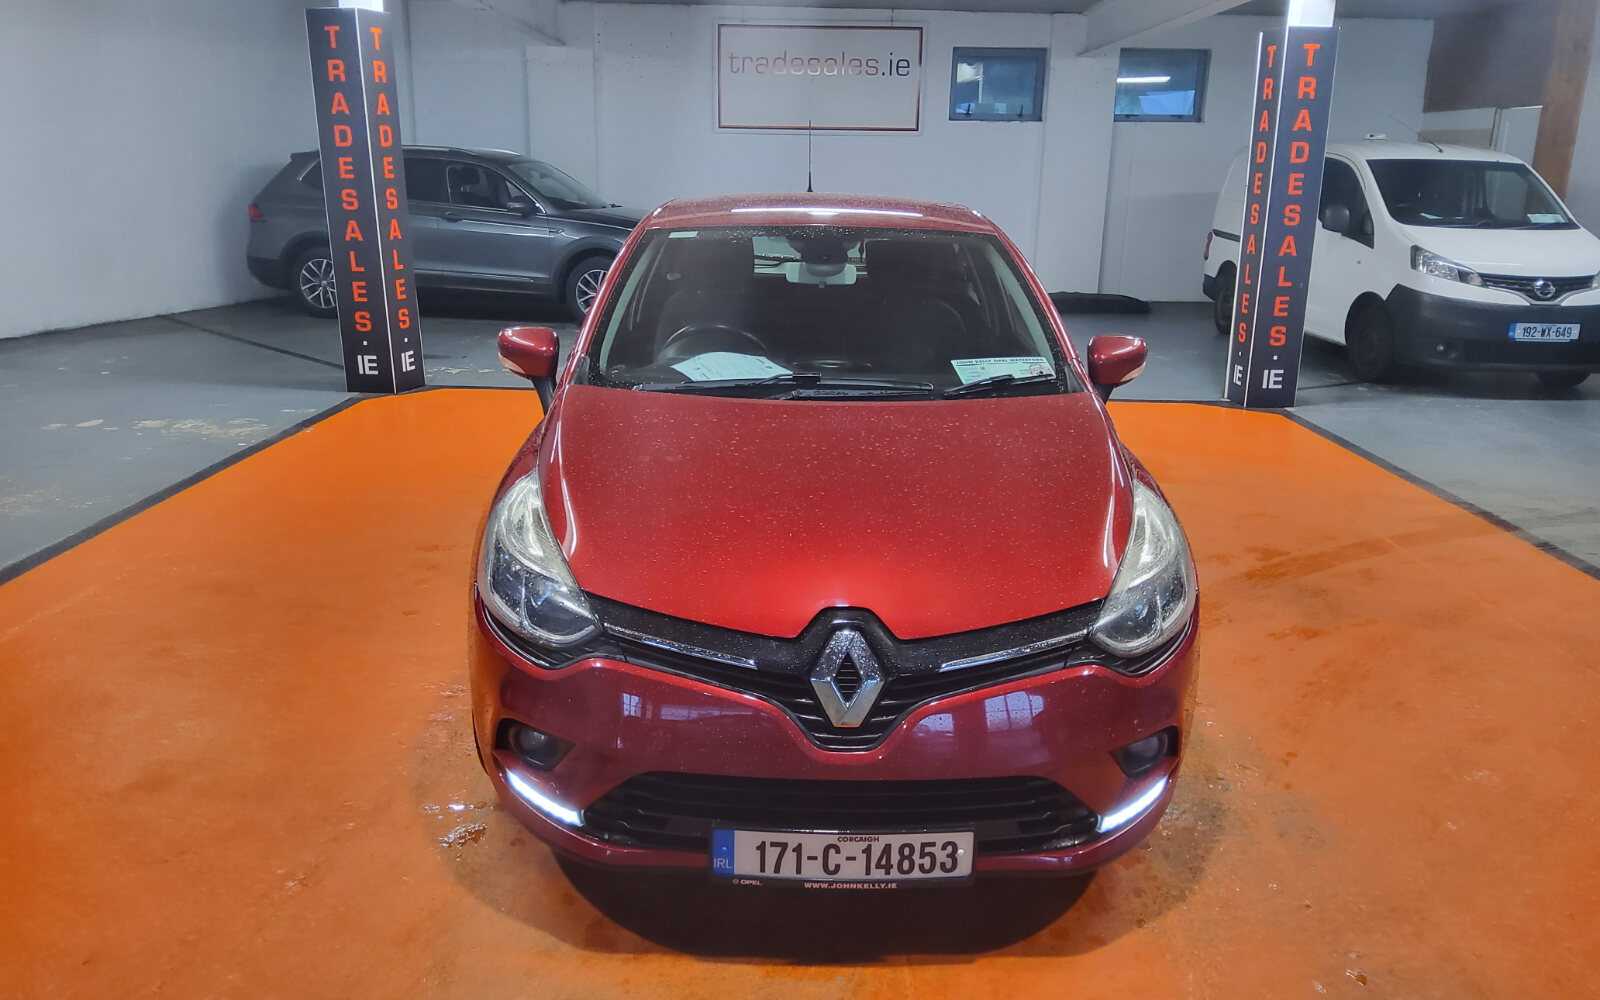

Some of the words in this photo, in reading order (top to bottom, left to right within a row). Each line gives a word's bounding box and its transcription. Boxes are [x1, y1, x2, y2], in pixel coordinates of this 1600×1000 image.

[728, 50, 911, 77] tradesales.ie
[1522, 326, 1572, 338] 192-WX-649
[713, 857, 733, 869] IRL
[755, 840, 959, 876] 171-C-14853
[804, 881, 898, 889] WWW.JOHNKELLY.IE
